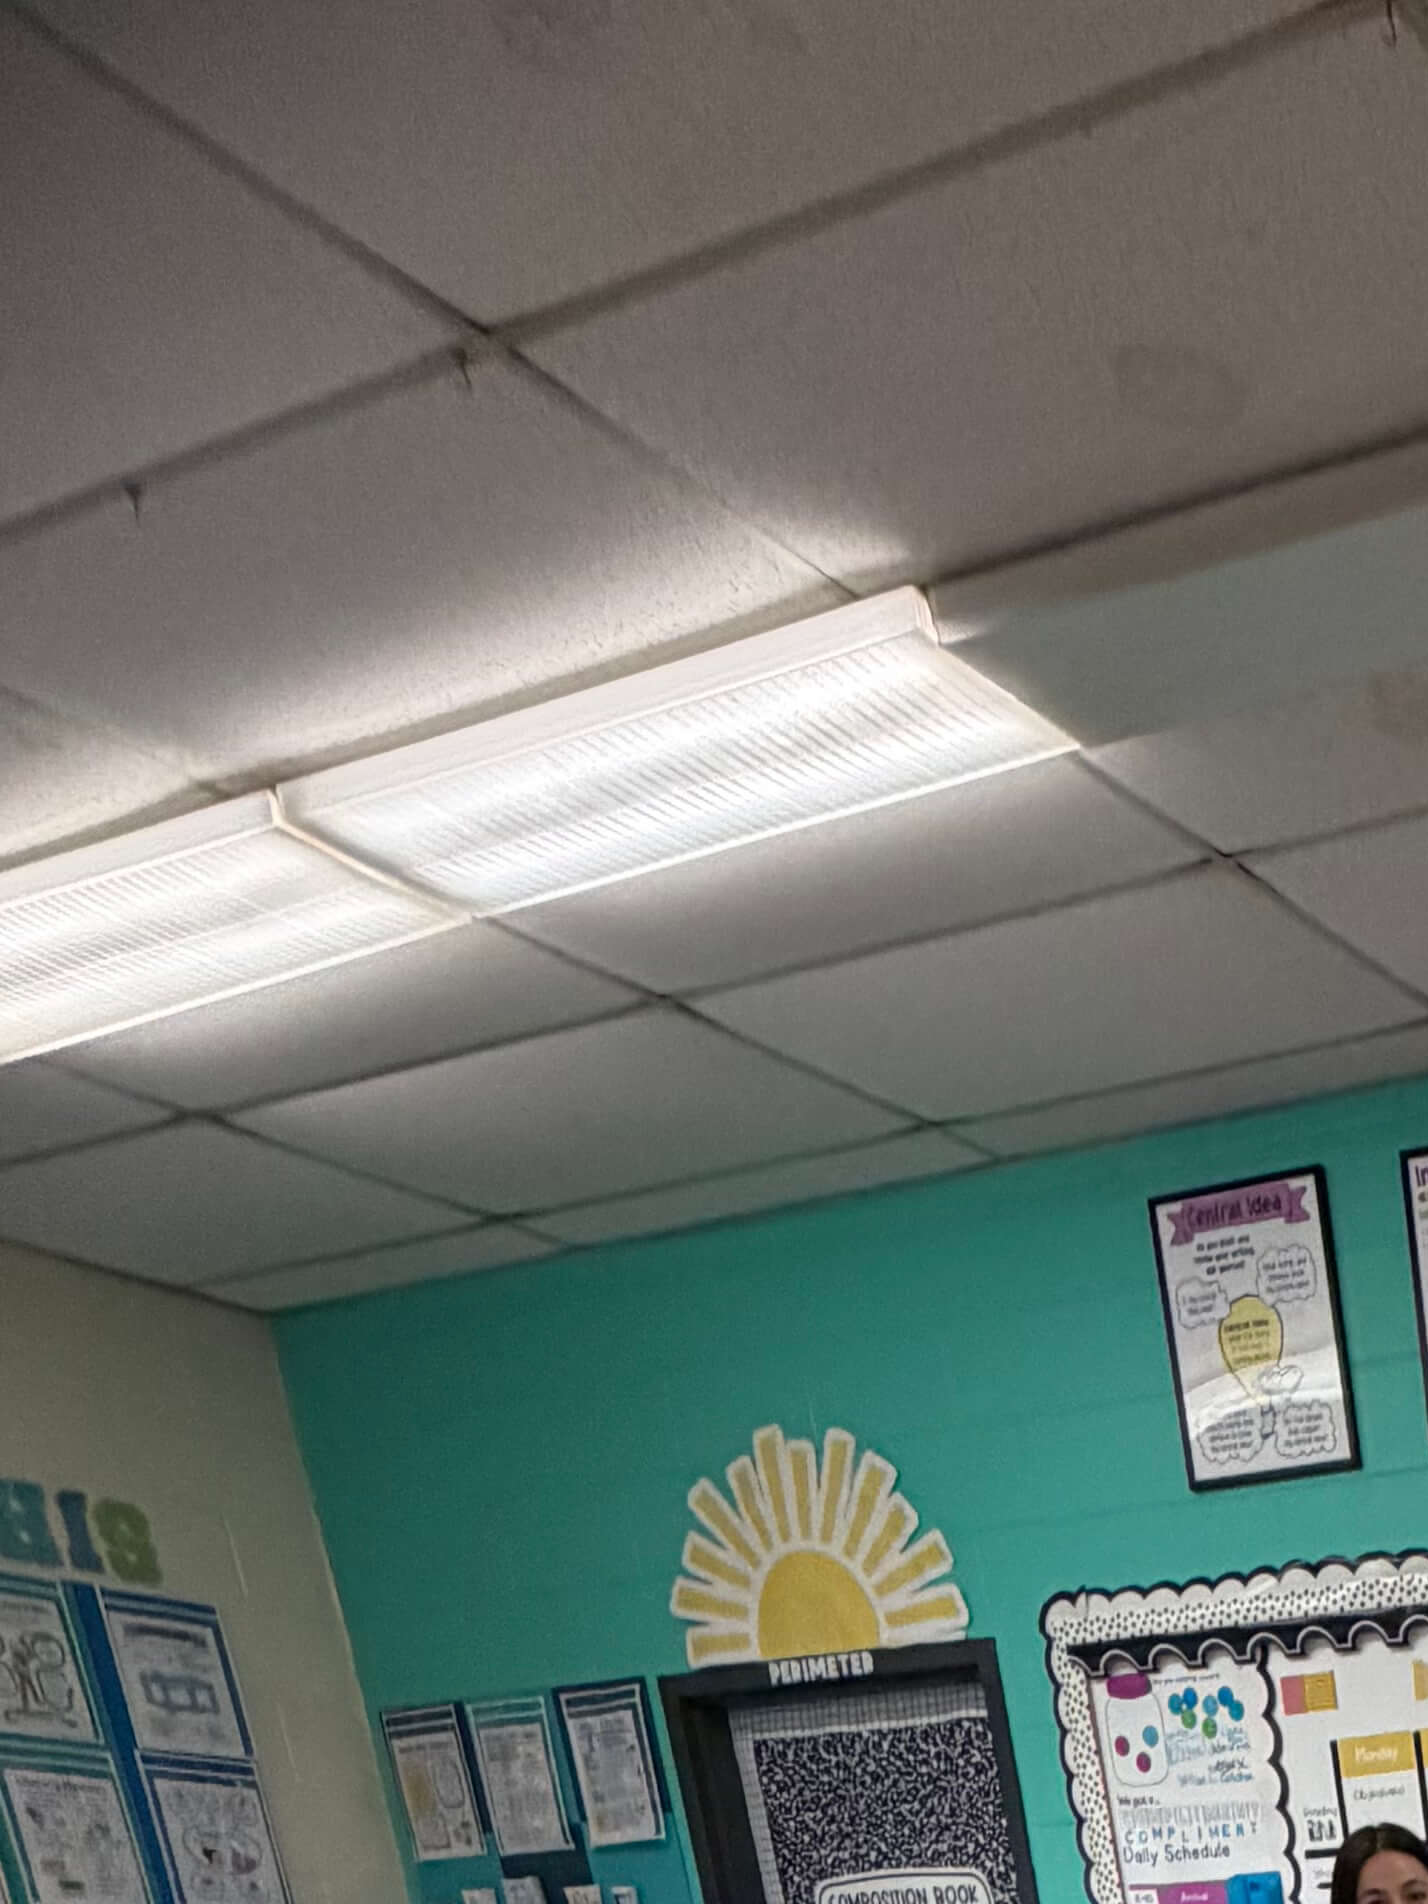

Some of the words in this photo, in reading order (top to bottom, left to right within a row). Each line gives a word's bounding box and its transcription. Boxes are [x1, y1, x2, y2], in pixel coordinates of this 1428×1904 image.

[1185, 1199, 1242, 1229] Central
[1248, 1193, 1282, 1217] Idea
[768, 1651, 875, 1686] PERIMETER
[1355, 1745, 1399, 1763] Monday
[1122, 1847, 1159, 1868] Daily
[1165, 1843, 1231, 1863] Schedule
